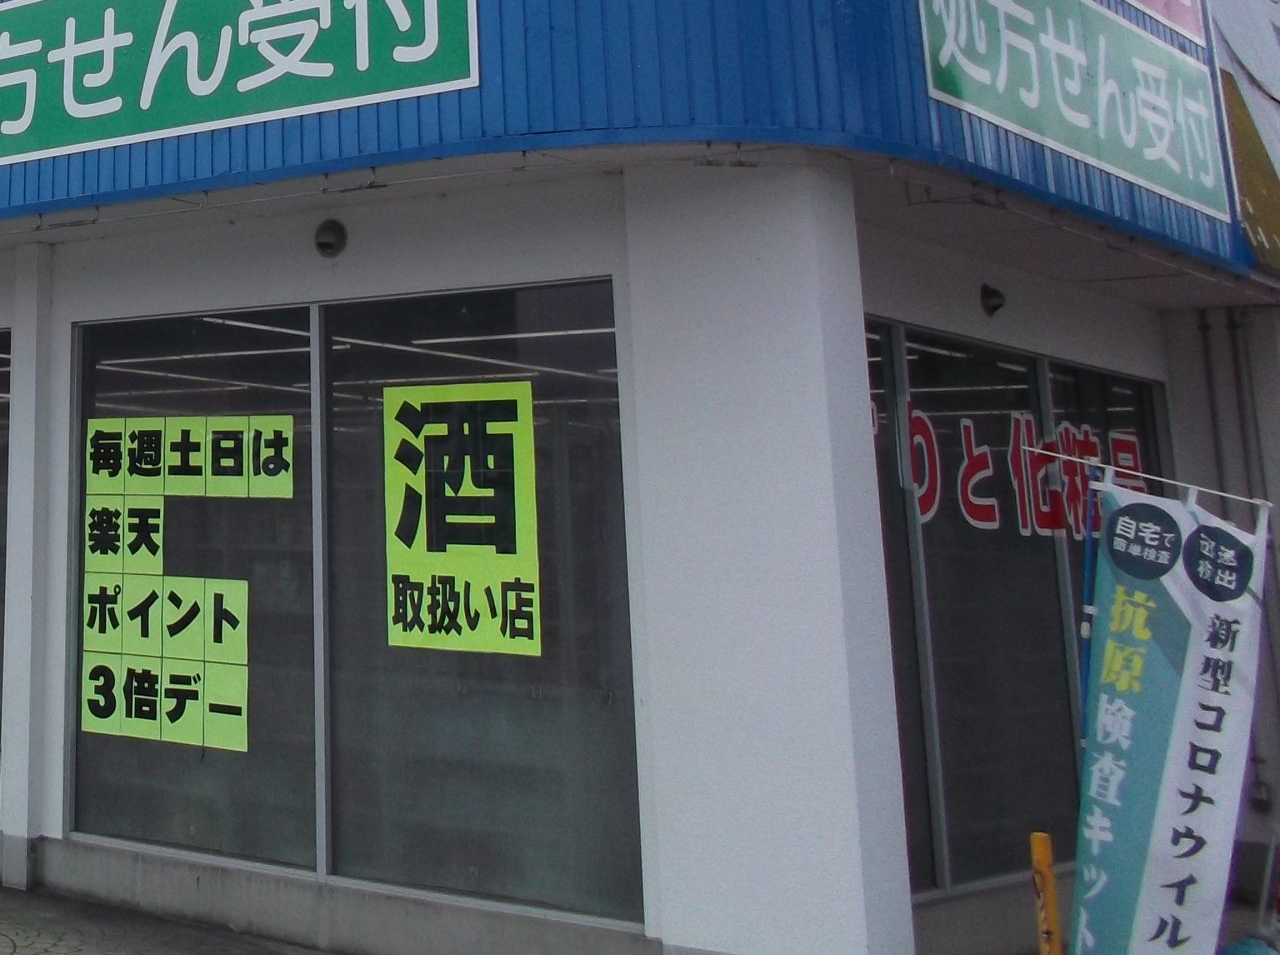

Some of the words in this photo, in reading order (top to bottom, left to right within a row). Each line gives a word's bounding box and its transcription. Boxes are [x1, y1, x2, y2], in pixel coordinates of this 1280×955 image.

[88, 428, 291, 478] 毎週土日は
[393, 399, 519, 556] 酒
[87, 507, 162, 557] 楽天
[1114, 515, 1176, 548] 自宅で
[86, 584, 241, 645] ポイント
[390, 573, 536, 641] 取扱い店
[86, 664, 243, 725] 3倍デー
